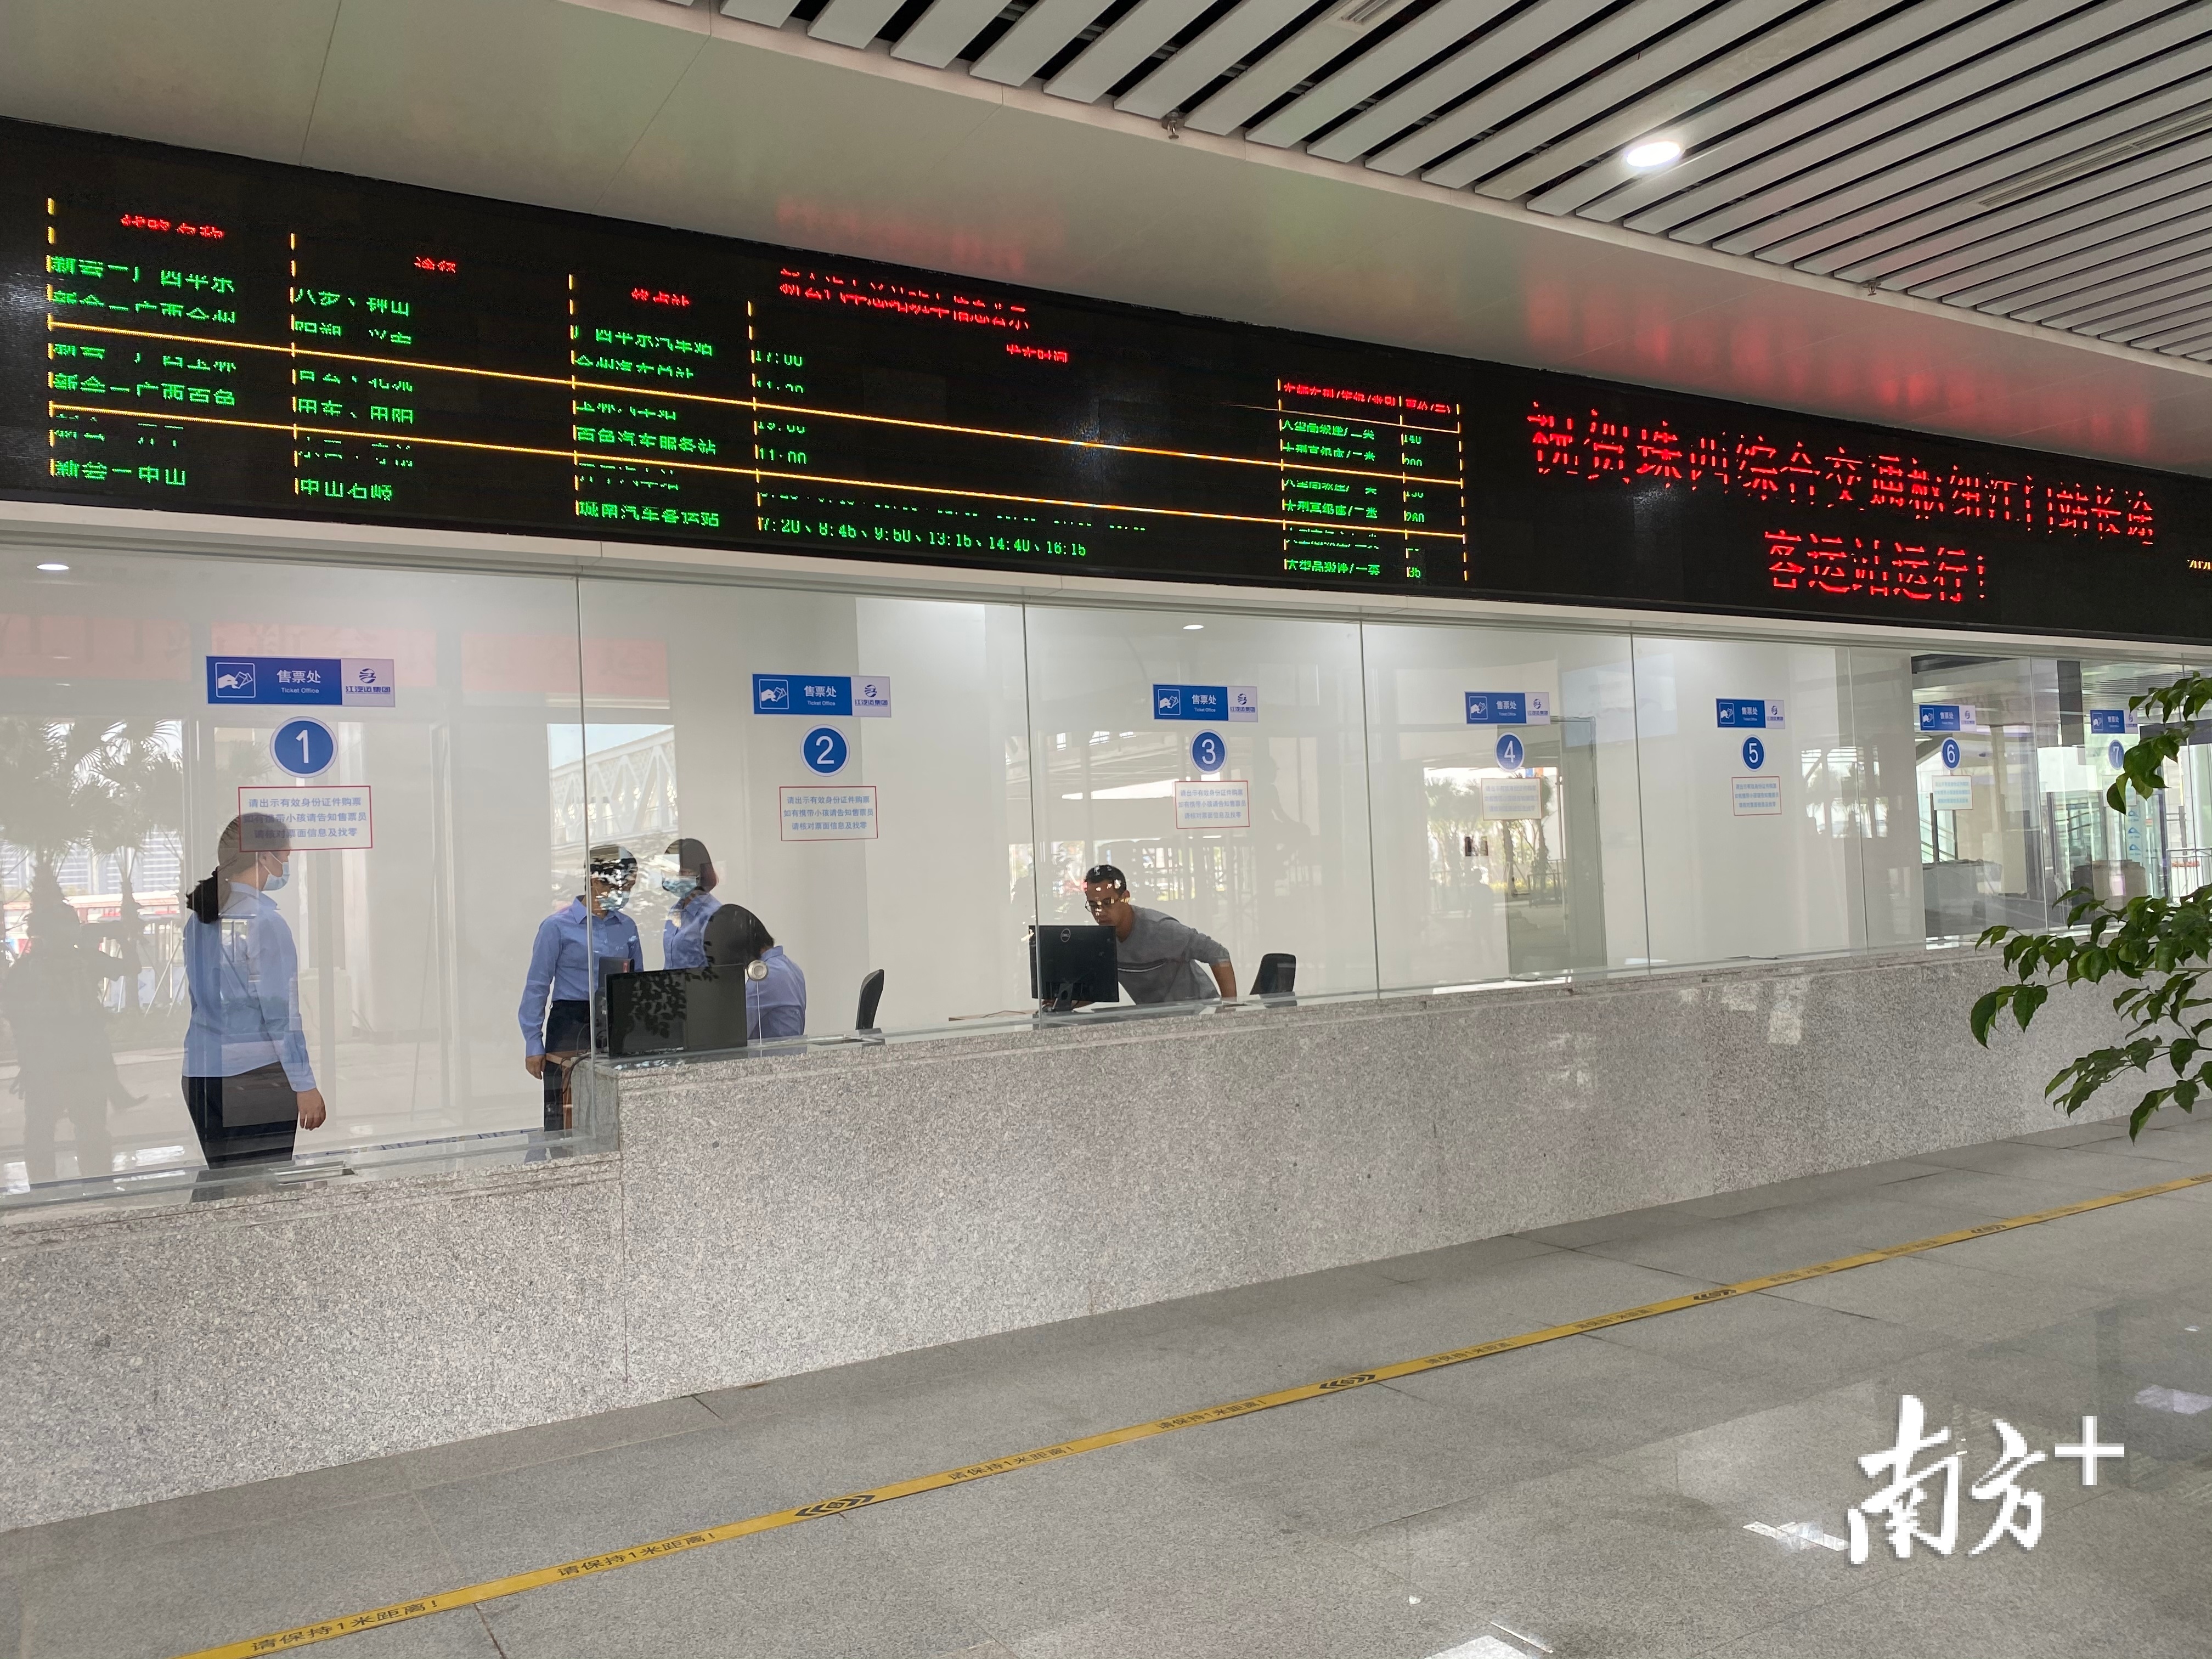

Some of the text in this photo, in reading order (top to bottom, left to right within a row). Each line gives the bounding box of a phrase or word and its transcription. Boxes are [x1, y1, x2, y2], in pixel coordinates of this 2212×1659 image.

[276, 669, 321, 684] 售票处
[804, 685, 837, 698] 售票处
[1192, 694, 1217, 705] 售票处
[1496, 700, 1517, 710] 售票处
[296, 729, 309, 764] 1
[815, 735, 835, 764] 2
[1201, 738, 1216, 765] 3
[1504, 740, 1516, 763] 4
[1748, 742, 1759, 764] 5
[1946, 744, 1956, 764] 6
[2113, 746, 2119, 764] 7
[249, 797, 362, 808] 请出示有效身份证件购票
[787, 795, 870, 804] 请出示有效身份证件购票
[783, 808, 874, 817] 如有携带小孩请告知售票员
[792, 821, 867, 831] 请核对票面信息及找零
[947, 1446, 1074, 1480] 请保持1米距离!
[557, 1532, 715, 1576] 请保持1米距离!
[251, 1599, 438, 1652] 请保持1米距离!
